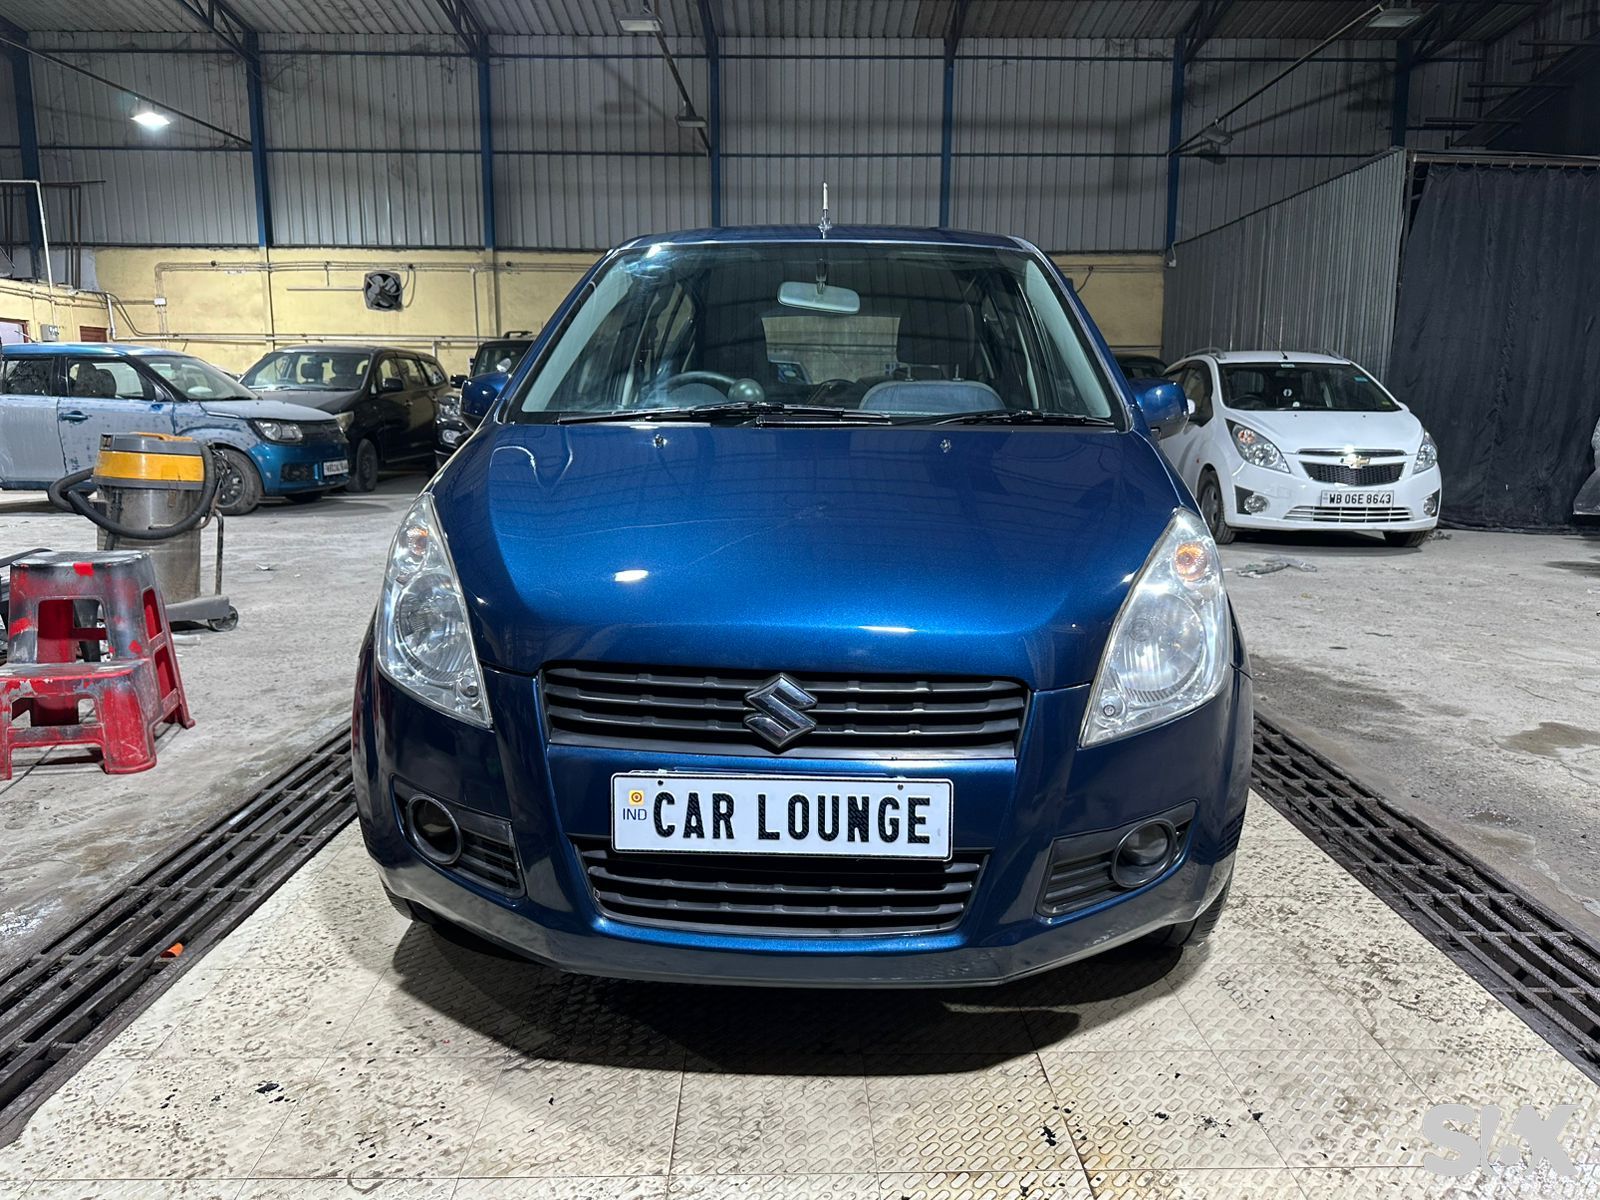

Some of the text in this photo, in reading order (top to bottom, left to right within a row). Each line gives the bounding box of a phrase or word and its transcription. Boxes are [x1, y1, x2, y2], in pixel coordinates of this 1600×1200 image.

[1329, 493, 1391, 504] WB 06E 8643
[622, 807, 648, 822] IND
[653, 791, 931, 844] CAR LOUNGE
